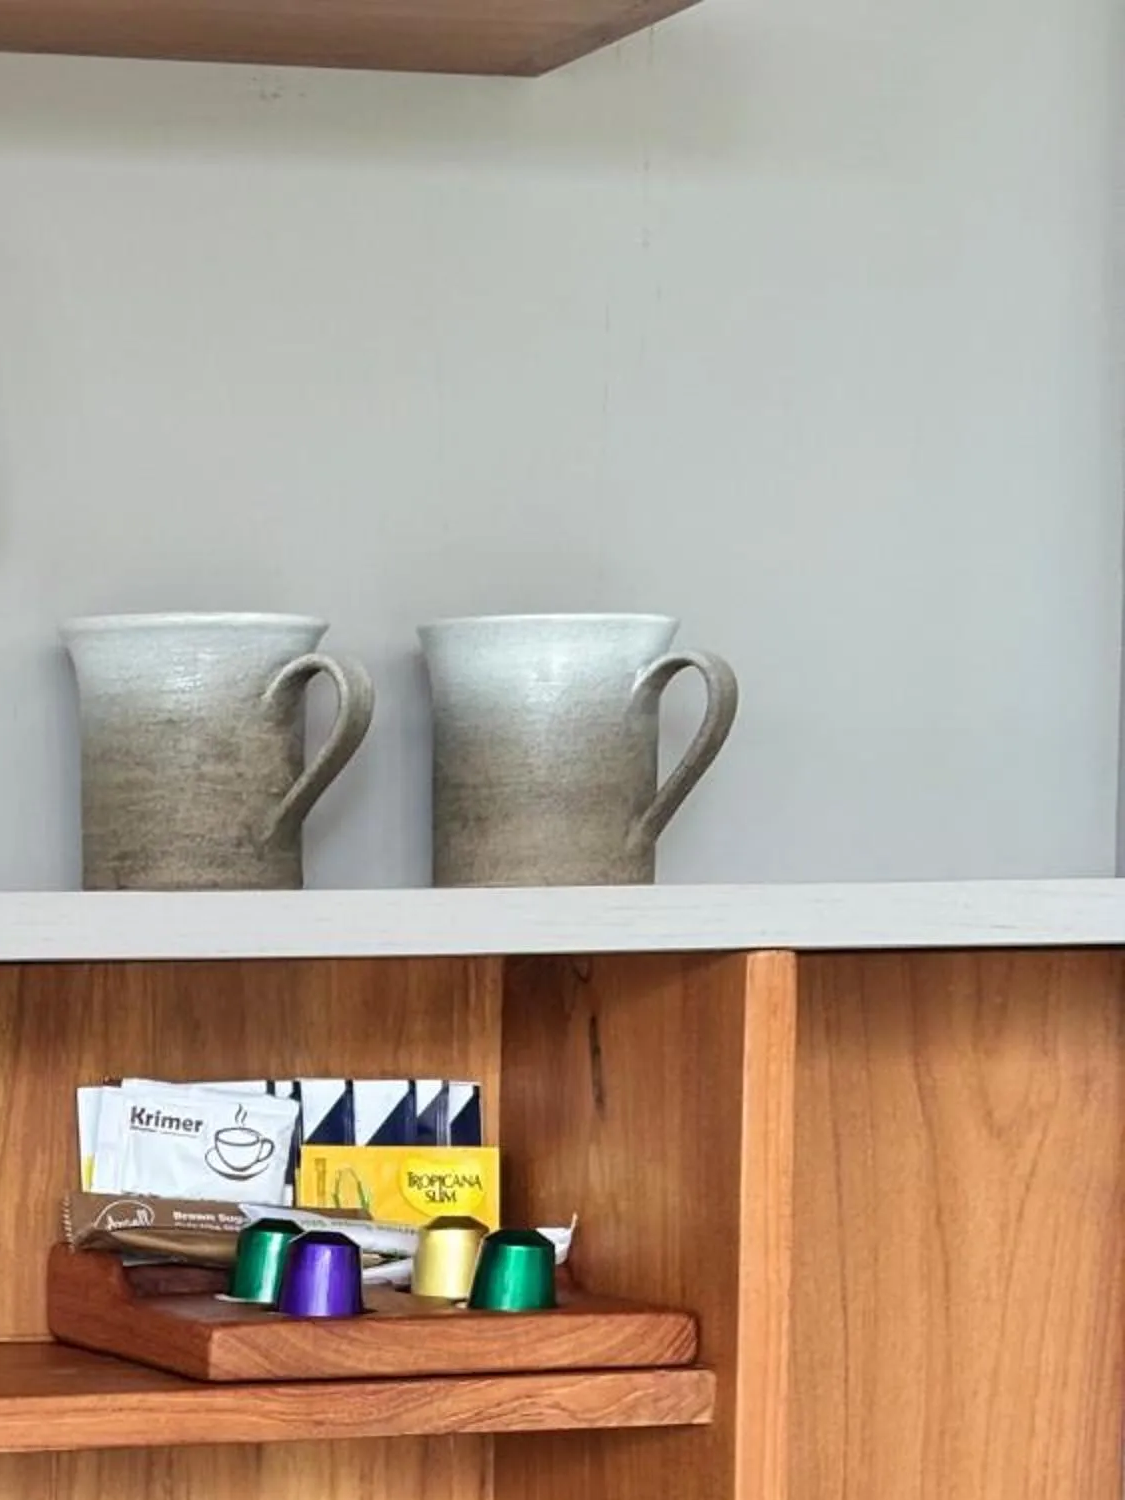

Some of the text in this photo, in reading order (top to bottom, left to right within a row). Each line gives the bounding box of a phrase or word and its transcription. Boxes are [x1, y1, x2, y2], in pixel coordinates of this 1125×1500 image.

[130, 1105, 204, 1132] Krimer
[407, 1171, 483, 1191] TROPICANA
[426, 1187, 457, 1204] SLIM
